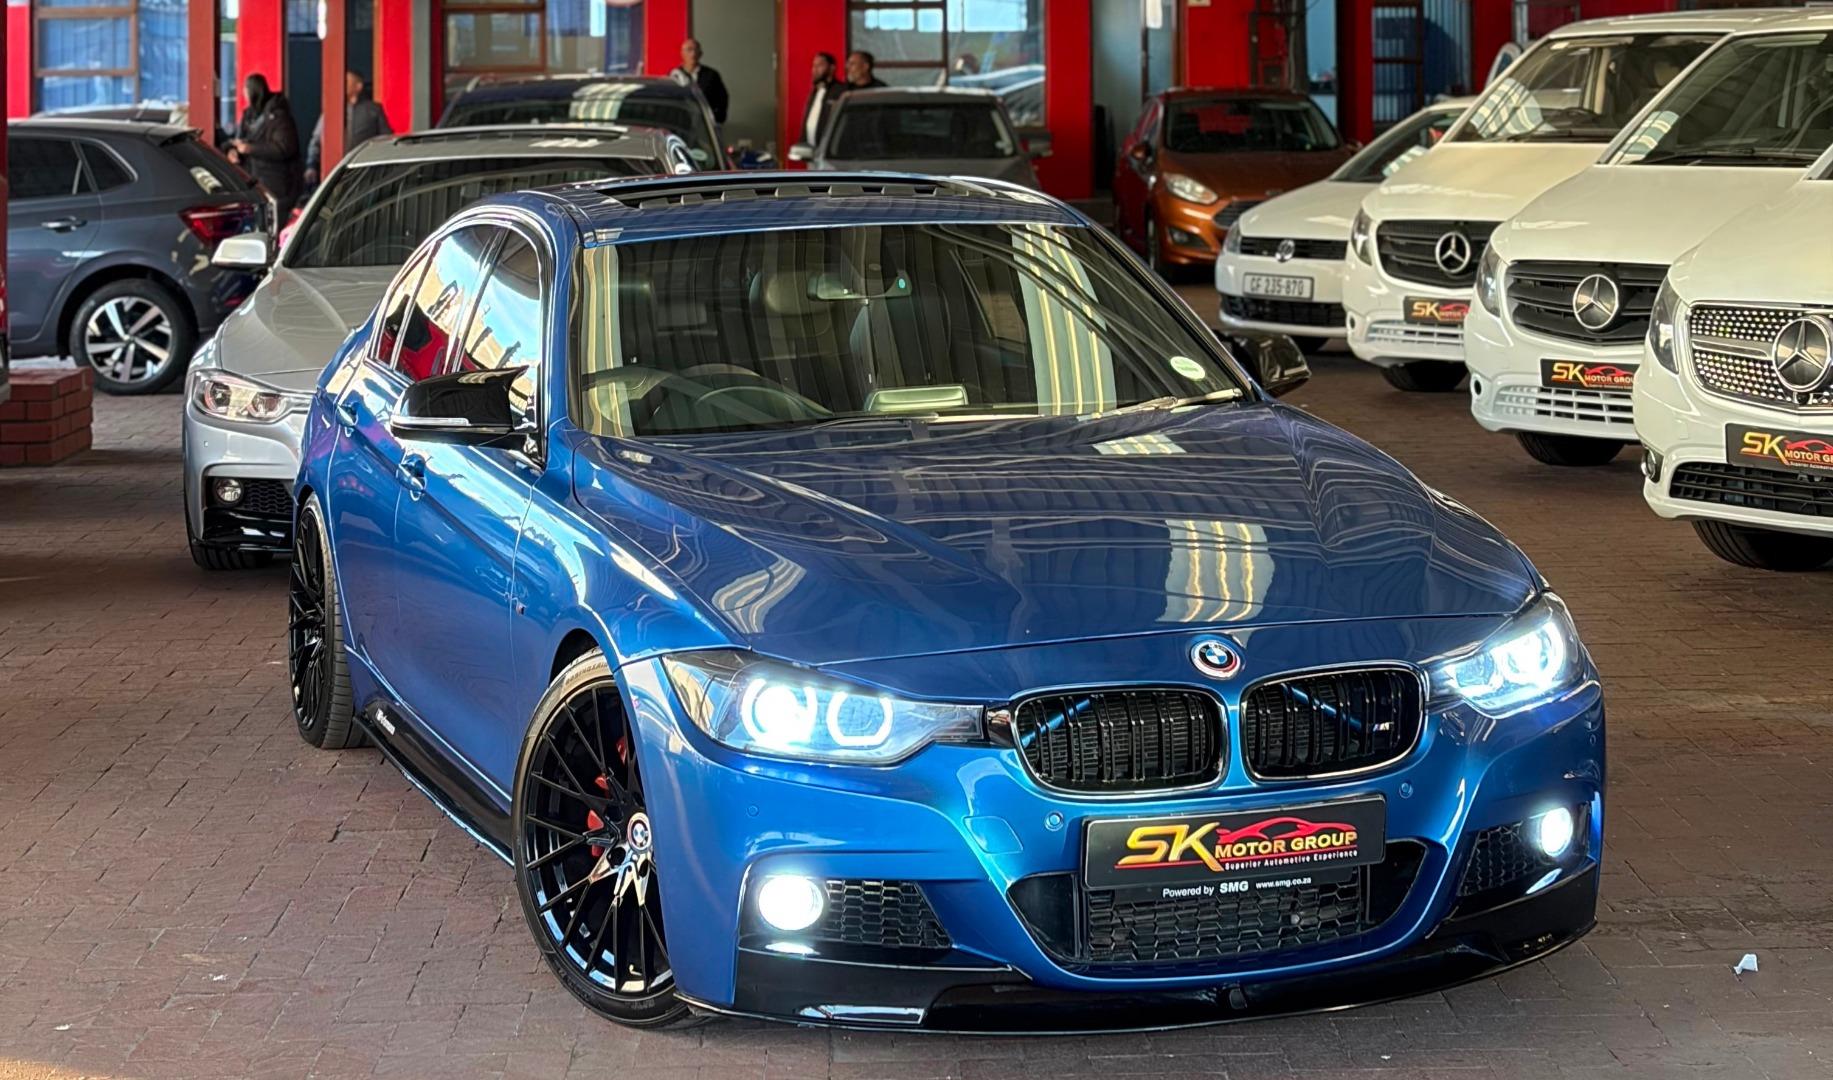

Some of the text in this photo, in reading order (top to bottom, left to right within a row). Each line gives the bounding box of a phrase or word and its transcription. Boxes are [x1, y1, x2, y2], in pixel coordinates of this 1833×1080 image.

[1411, 302, 1440, 320] SK
[1551, 363, 1588, 387] SK
[1741, 431, 1790, 466] SK
[1784, 450, 1821, 462] MOTOR
[1117, 822, 1358, 872] SK MOTOR GROUP
[1225, 849, 1358, 871] Superior Automotive Experience
[1162, 876, 1312, 898] Powered by SMG www.smg.co.za
